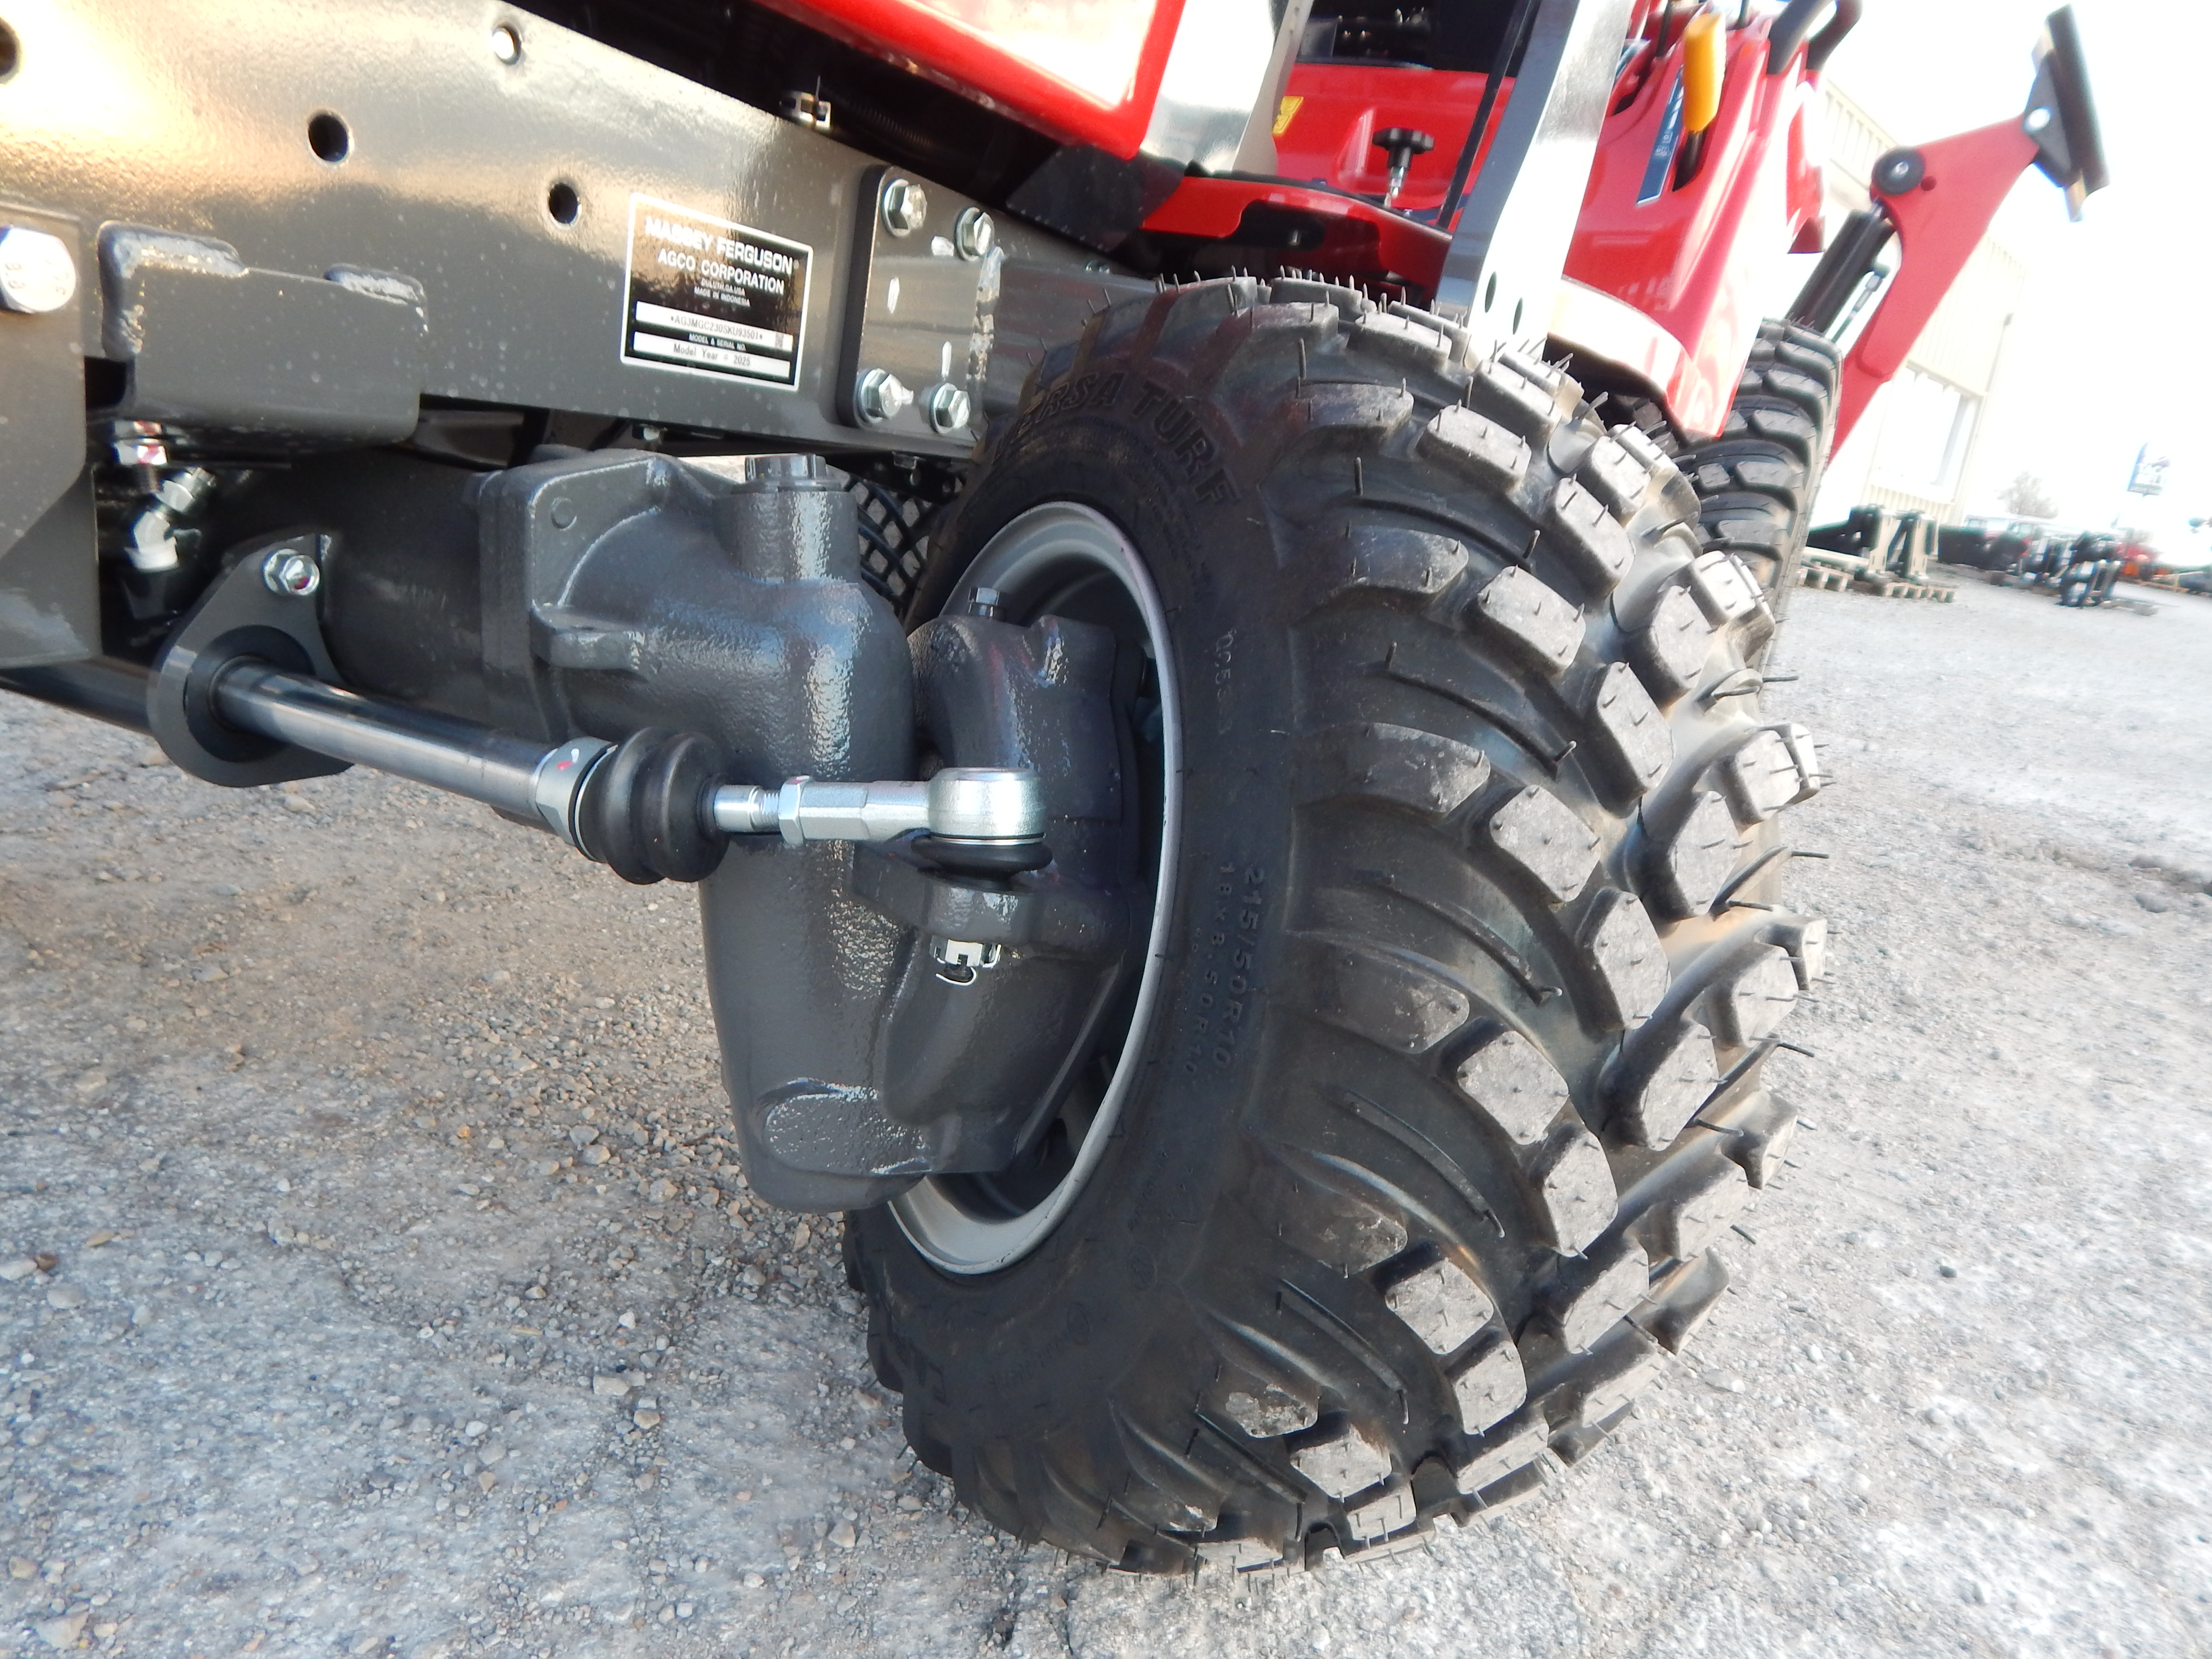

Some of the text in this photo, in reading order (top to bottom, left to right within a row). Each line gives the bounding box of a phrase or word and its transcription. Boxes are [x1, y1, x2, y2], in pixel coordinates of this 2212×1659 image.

[658, 248, 784, 295] AGCO CORPORATION
[717, 236, 793, 275] FERGUSON
[694, 286, 751, 307] MADE IN INDONESIA
[673, 343, 696, 356] Model
[702, 348, 718, 360] Year
[733, 355, 750, 366] 2025
[688, 333, 709, 345] MODEL
[1131, 377, 1241, 505] TURF
[1213, 865, 1265, 1068] 215/50R10
